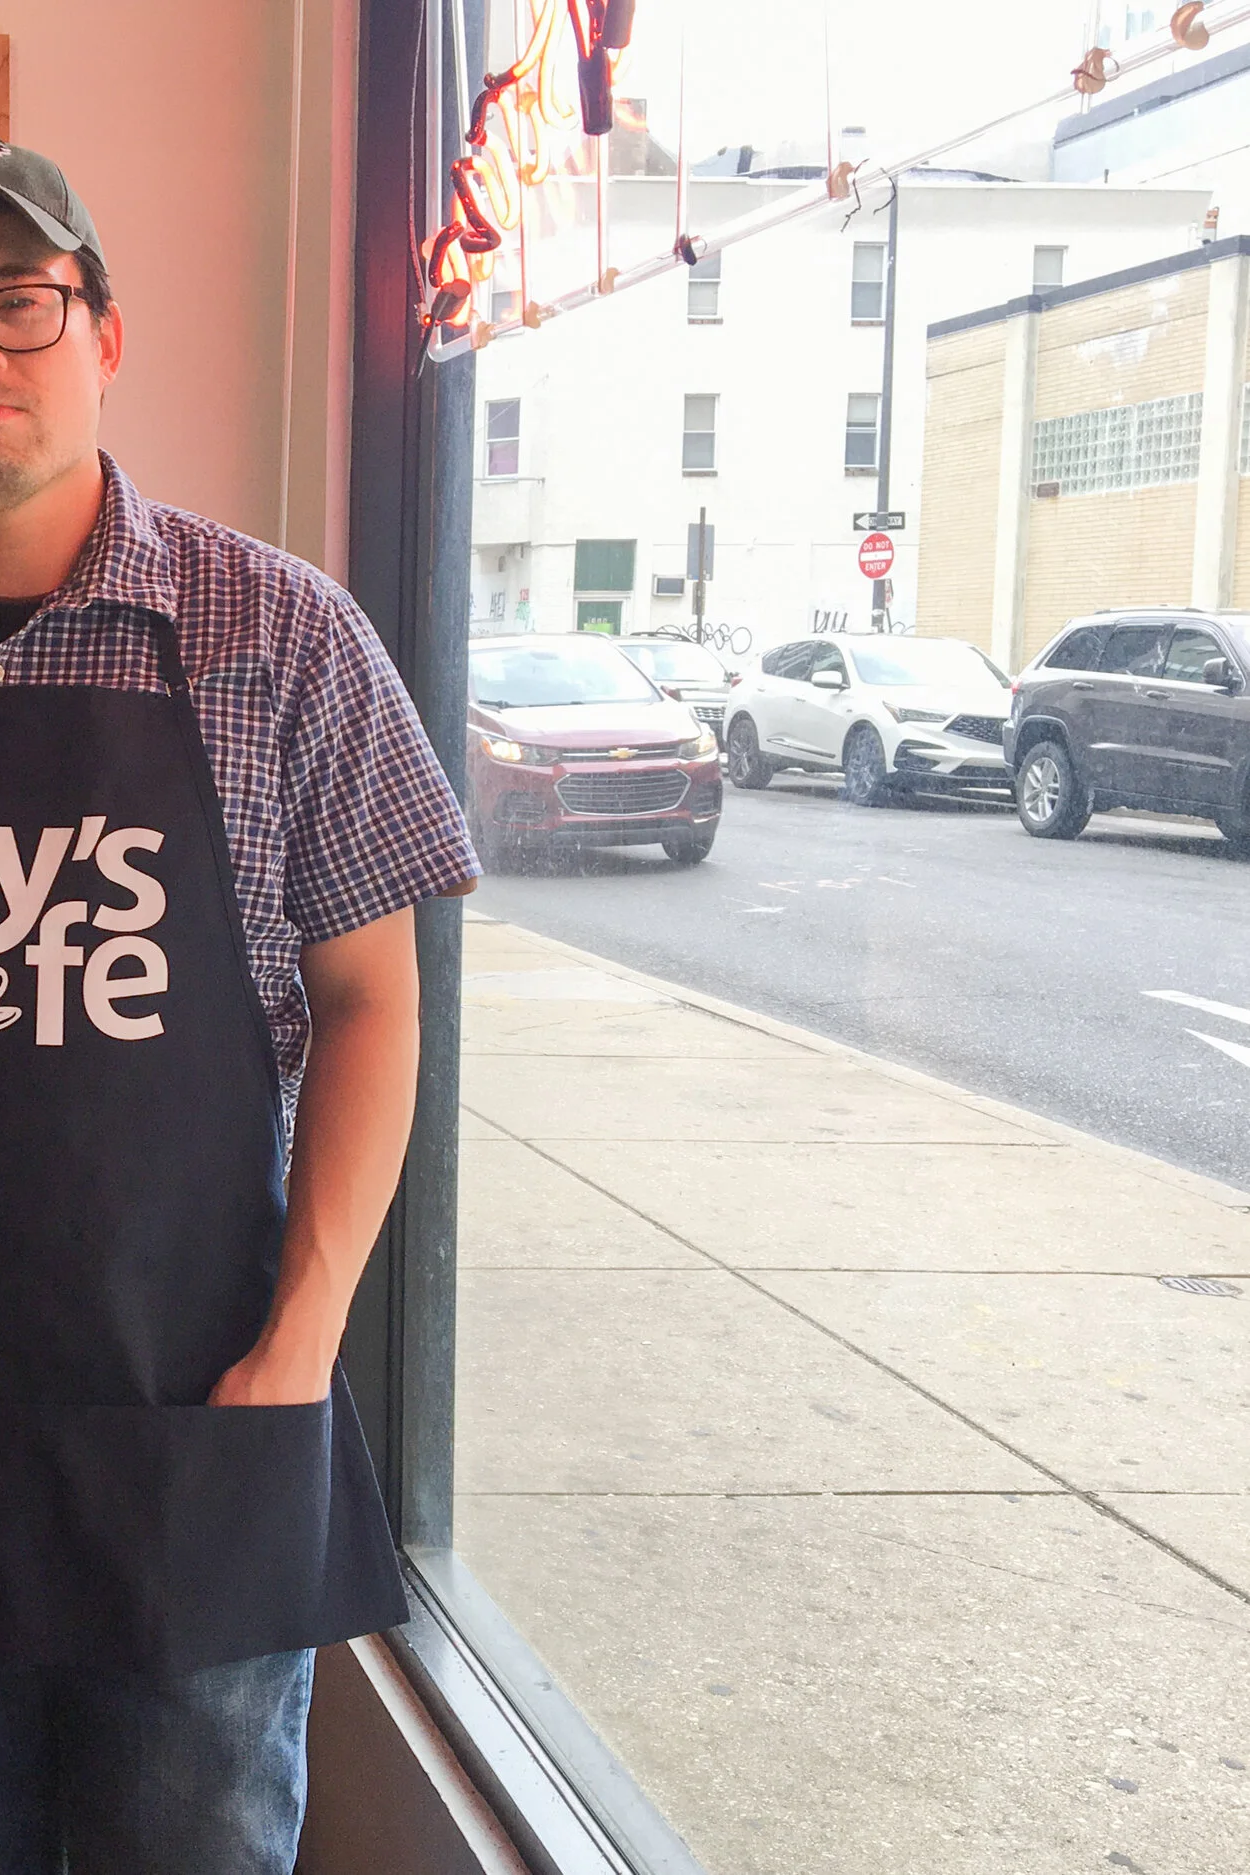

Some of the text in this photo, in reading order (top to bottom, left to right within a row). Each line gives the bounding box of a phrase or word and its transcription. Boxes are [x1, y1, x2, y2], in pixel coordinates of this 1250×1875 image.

[863, 541, 889, 550] DO NOT
[865, 562, 886, 570] ENTER
